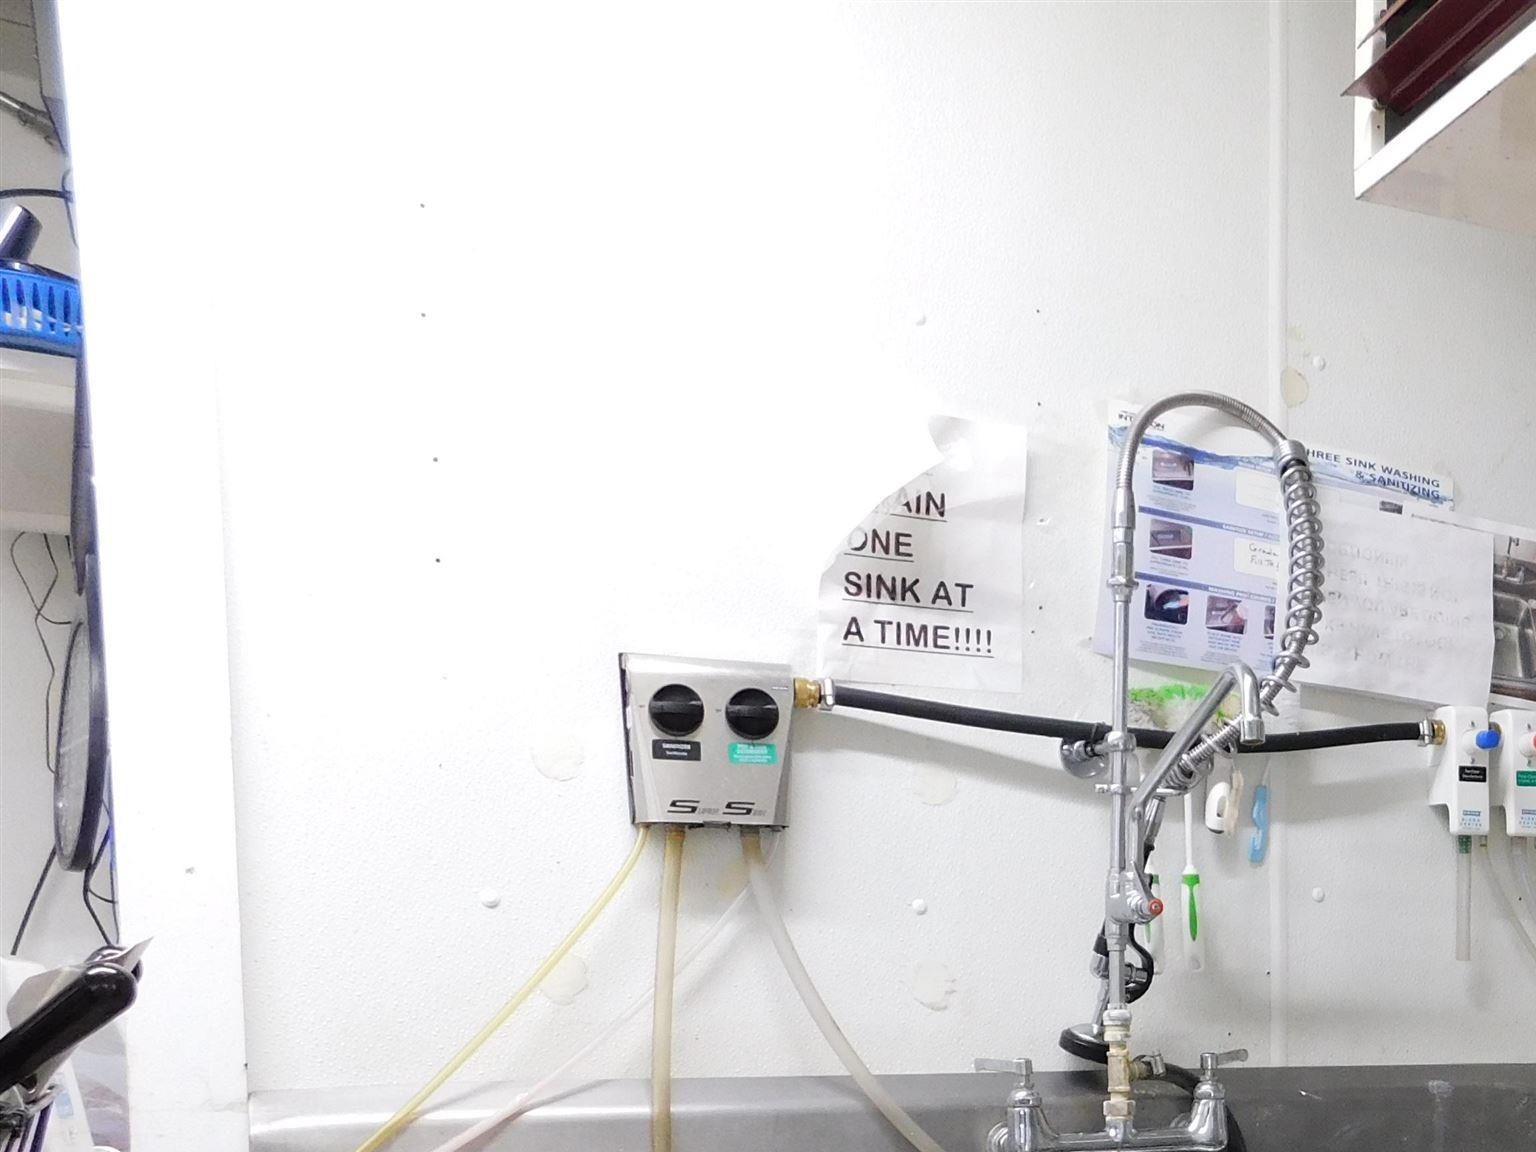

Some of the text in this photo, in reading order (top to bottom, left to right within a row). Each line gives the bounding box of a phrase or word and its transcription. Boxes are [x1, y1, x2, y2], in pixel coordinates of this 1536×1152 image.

[1305, 448, 1441, 488] HREE SINK WASHING
[1368, 473, 1441, 500] SANITIZING
[848, 528, 914, 558] ONE
[843, 571, 975, 608] SINK AT
[843, 616, 993, 654] A TIME!!!!
